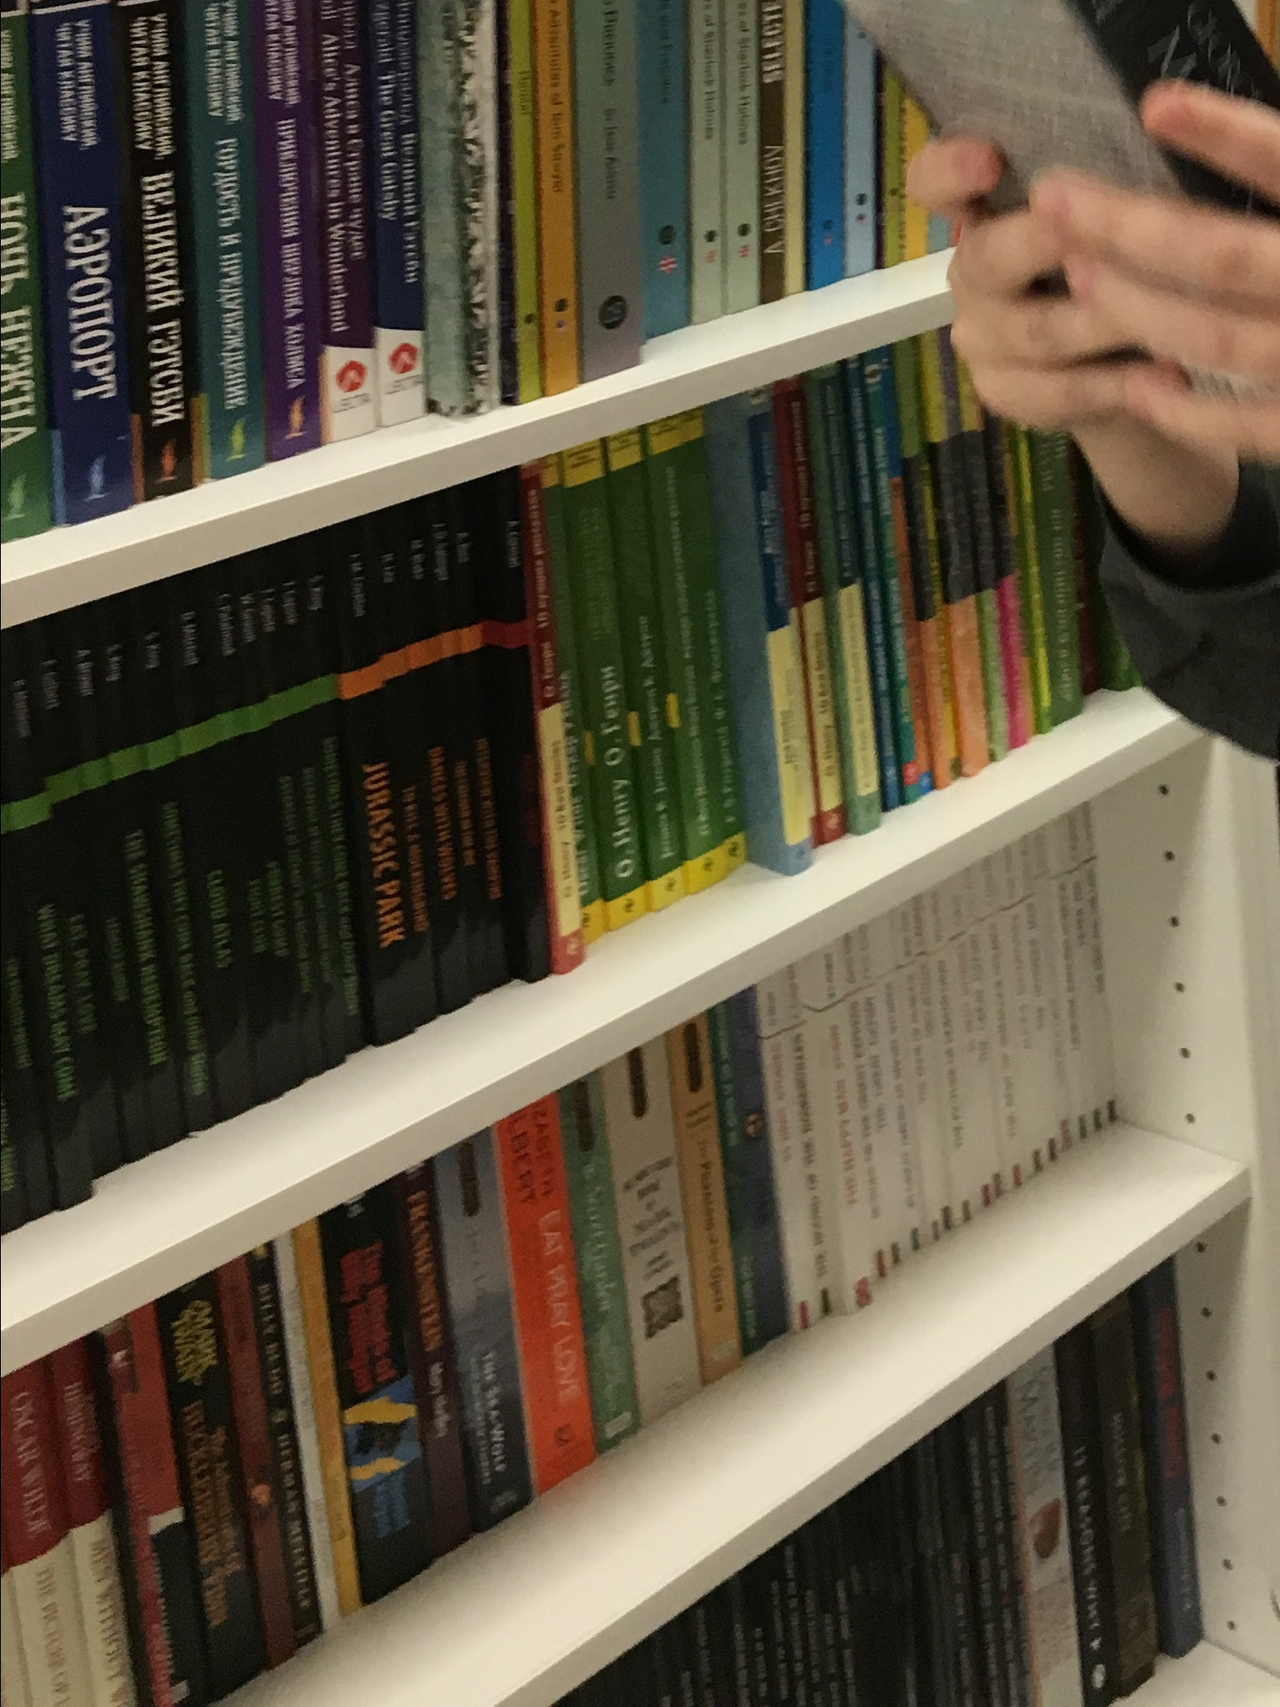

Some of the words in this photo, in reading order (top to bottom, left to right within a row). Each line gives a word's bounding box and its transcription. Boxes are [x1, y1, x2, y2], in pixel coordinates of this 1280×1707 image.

[54, 21, 77, 70] ЧИТАЙ
[72, 18, 94, 60] УЧИМ
[129, 17, 153, 68] ЧИТАЙ
[149, 12, 171, 58] УЧИМ
[203, 2, 225, 45] ЧИТАЙ
[549, 8, 566, 88] Adventures
[206, 47, 227, 117] КЛАССИКУ
[223, 38, 247, 125] АНГЛИЙСКИЙ,
[267, 35, 286, 101] КЛАССИКУ
[283, 24, 303, 108] АНГЛИЙСКИЙ,
[323, 31, 346, 91] Alice's
[345, 62, 365, 119] Алиса
[377, 69, 396, 105] The
[737, 37, 753, 91] Sherlock
[58, 72, 81, 144] КЛАССИКУ
[74, 62, 101, 151] АНГЛИЙСКИЙ,
[131, 70, 155, 151] КЛАССИКУ
[152, 60, 177, 161] АНГЛИЙСКИЙ,
[551, 92, 567, 106] of
[551, 111, 569, 141] Tom
[738, 95, 755, 145] Holmes
[325, 94, 347, 198] Adventures
[378, 109, 400, 158] Great
[211, 136, 243, 228] ГОРДОСТЬ
[275, 118, 302, 238] ПРИКЛЮЧЕНИЯ
[346, 139, 367, 202] Стране
[378, 161, 402, 222] Gatsby
[402, 131, 421, 216] Великий
[549, 144, 571, 194] Sawyer
[762, 144, 787, 233] CHEKHOV
[140, 170, 185, 314] ВЕЛИКИЙ
[219, 232, 243, 249] И
[346, 205, 369, 261] чудес
[403, 221, 424, 285] Гэтсби
[60, 204, 118, 403] АЭРОПОРТ
[282, 242, 305, 319] ШЕРЛОКА
[328, 224, 352, 333] Wonderland
[217, 251, 249, 411] ПРЕДУБЕЖДЕНИЕ
[284, 324, 307, 390] ХОЛМСА
[0, 304, 36, 450] НЕЖНА
[147, 317, 187, 429] ГЭТСБИ
[426, 745, 450, 801] DANCES
[361, 760, 401, 878] JURASSIC
[434, 803, 454, 843] WITH
[205, 868, 228, 918] CLOUD
[438, 843, 460, 900] WOLVES
[123, 828, 146, 860] THE
[139, 963, 168, 1065] REDEMPTION
[373, 879, 406, 949] PARK
[37, 902, 62, 950] WHAT
[55, 1054, 80, 1103] COME
[537, 1208, 566, 1256] EAT
[407, 1188, 443, 1353] FRANKENSTEIN
[543, 1262, 573, 1327] PRAY
[255, 1282, 281, 1337] BILLY
[264, 1342, 287, 1397] BUDD
[551, 1336, 582, 1404] LOVE
[8, 1390, 45, 1467] OSCAR
[17, 1466, 52, 1540] WILDE
